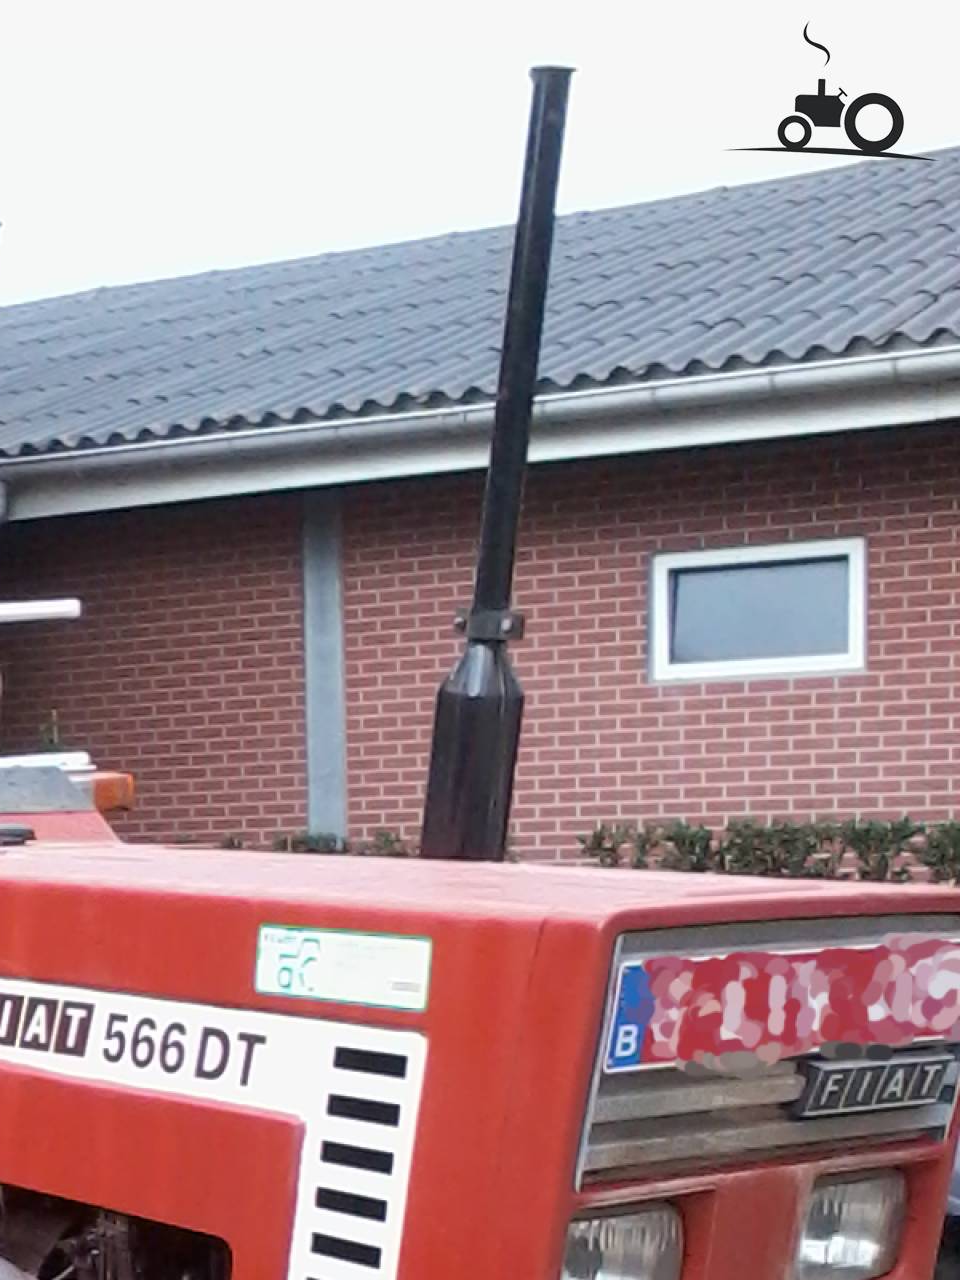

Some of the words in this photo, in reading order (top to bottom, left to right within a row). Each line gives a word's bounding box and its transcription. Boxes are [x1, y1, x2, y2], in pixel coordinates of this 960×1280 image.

[102, 1013, 186, 1074] 566
[195, 1026, 267, 1087] DT
[614, 1025, 639, 1058] B
[819, 1063, 944, 1107] FIAT
